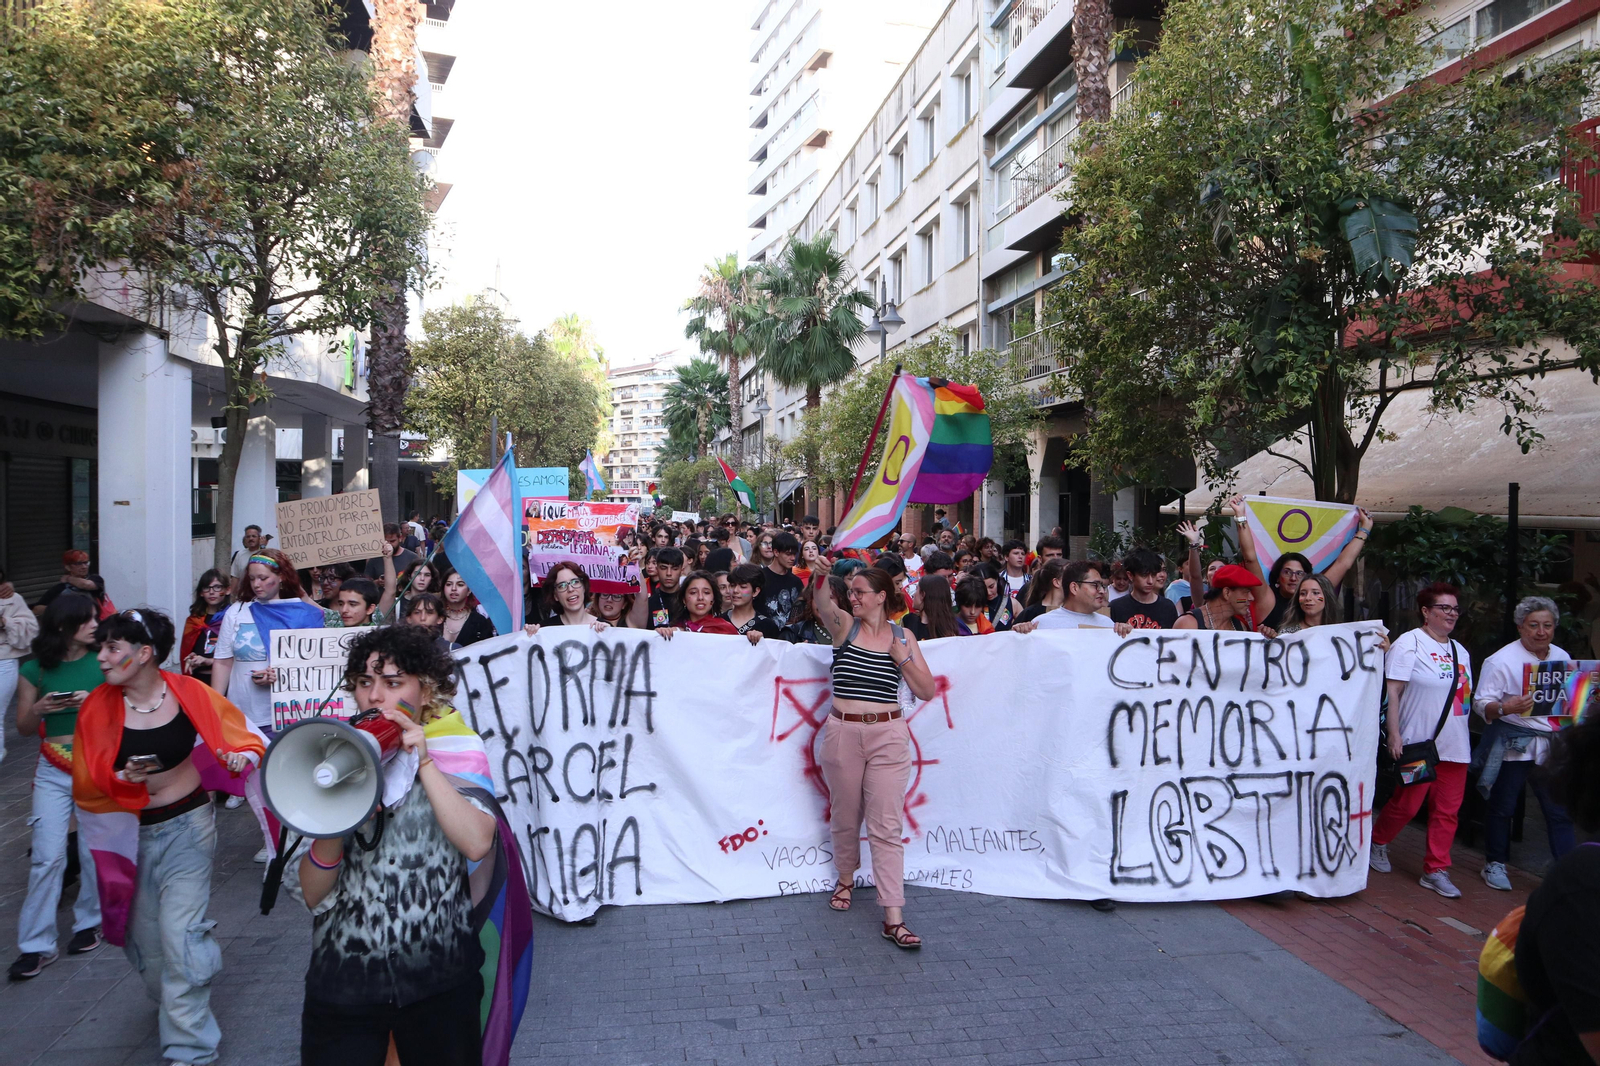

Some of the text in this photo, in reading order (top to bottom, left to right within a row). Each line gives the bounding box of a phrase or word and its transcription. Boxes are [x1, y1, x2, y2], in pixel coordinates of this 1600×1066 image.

[278, 492, 373, 519] MIS PRONOMBRES
[567, 507, 588, 519] MALA
[279, 510, 369, 536] NO ESTÁN PARA
[356, 521, 381, 537] ESTÁN
[288, 551, 308, 564] ARA
[569, 544, 610, 557] LESBIANA
[588, 564, 627, 582] LESBIANS!
[278, 632, 357, 661] NUES
[1107, 630, 1377, 691] CENTRO DE
[272, 665, 347, 693] IDENTI
[1529, 670, 1583, 686] LIBRE
[453, 639, 657, 749] EFORMA
[274, 697, 351, 731] INVIOL
[1107, 693, 1353, 769] MEMORIA
[495, 733, 657, 807] ARCEL
[1109, 770, 1373, 888] LGBTIQ+
[761, 824, 1046, 871] VAGOS MALEANTES,
